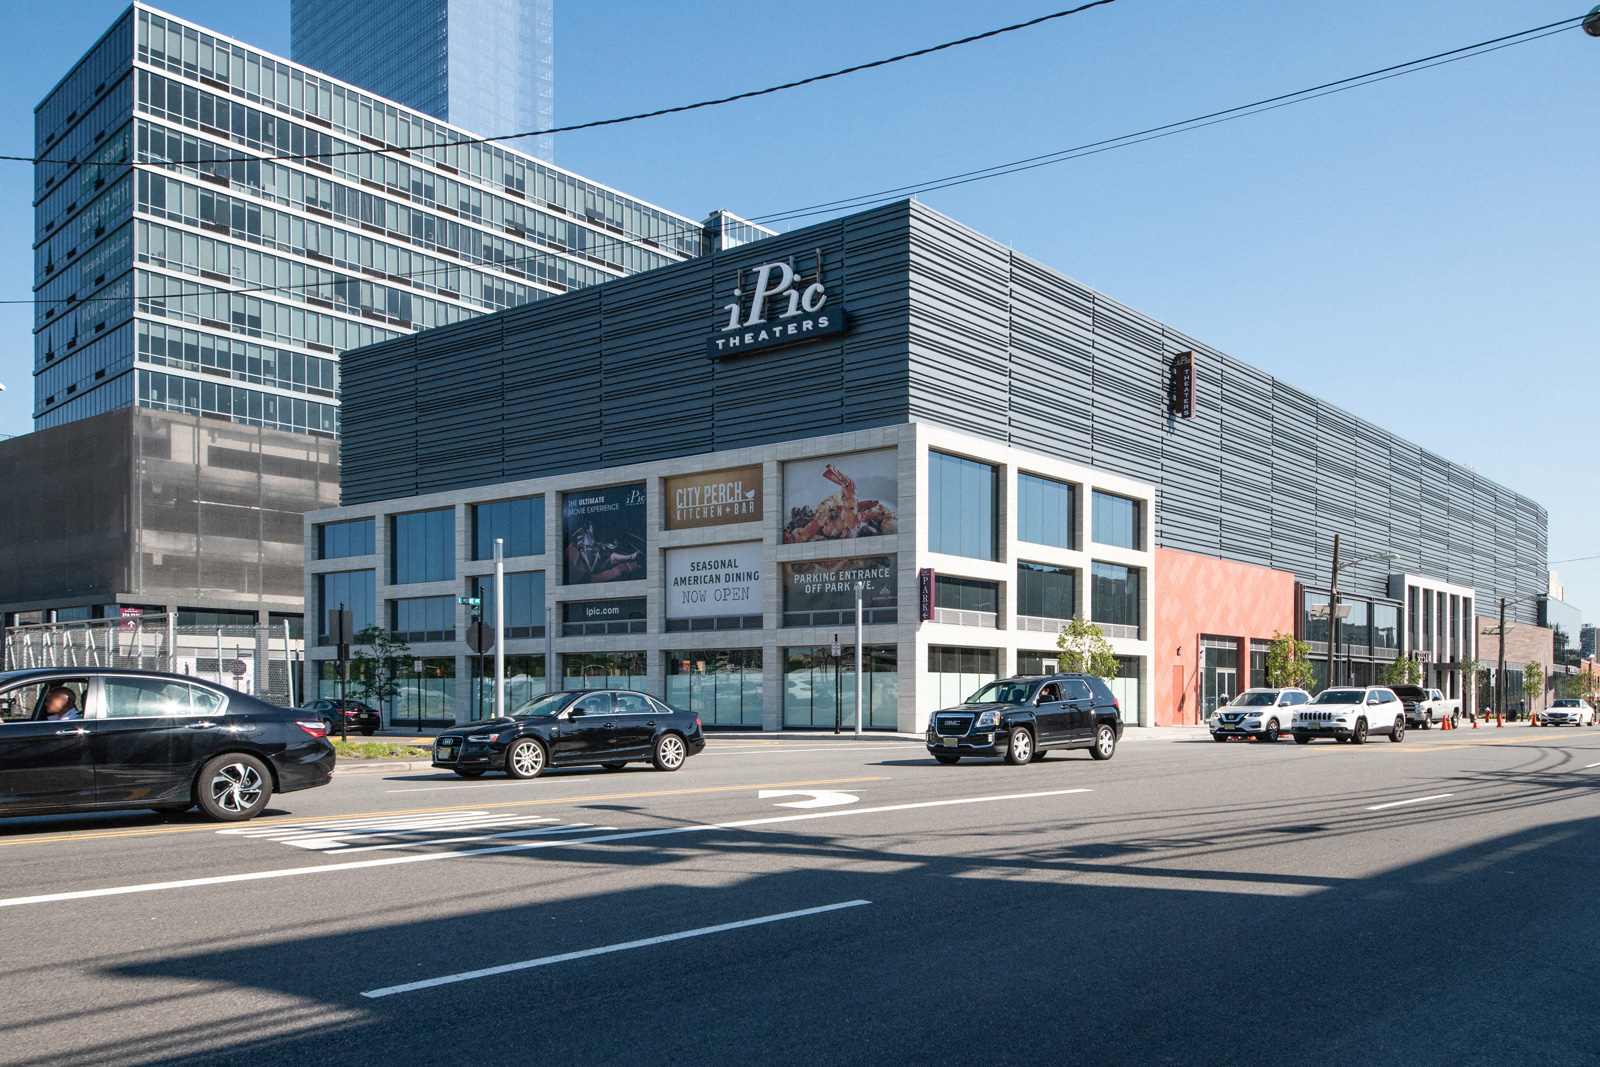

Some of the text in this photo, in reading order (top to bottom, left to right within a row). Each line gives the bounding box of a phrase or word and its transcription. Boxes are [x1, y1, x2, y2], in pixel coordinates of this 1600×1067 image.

[721, 262, 828, 332] iPic
[716, 316, 829, 350] THEATERS
[568, 496, 605, 507] THE ULTIMATE
[626, 490, 646, 504] iPic
[676, 481, 742, 508] CITY PERCH
[567, 508, 586, 516] MOVIE
[586, 503, 620, 514] EXPERIENCE
[676, 505, 722, 521] KITCHEN
[734, 502, 755, 515] BAR
[690, 558, 738, 572] SEASONAL
[672, 570, 760, 587] AMERICAN DINING
[794, 568, 890, 584] PARKING ENTRANCE
[682, 586, 750, 604] NOW OPEN
[804, 584, 822, 594] OFF
[824, 582, 850, 593] PARK
[586, 607, 620, 618] ipic.com
